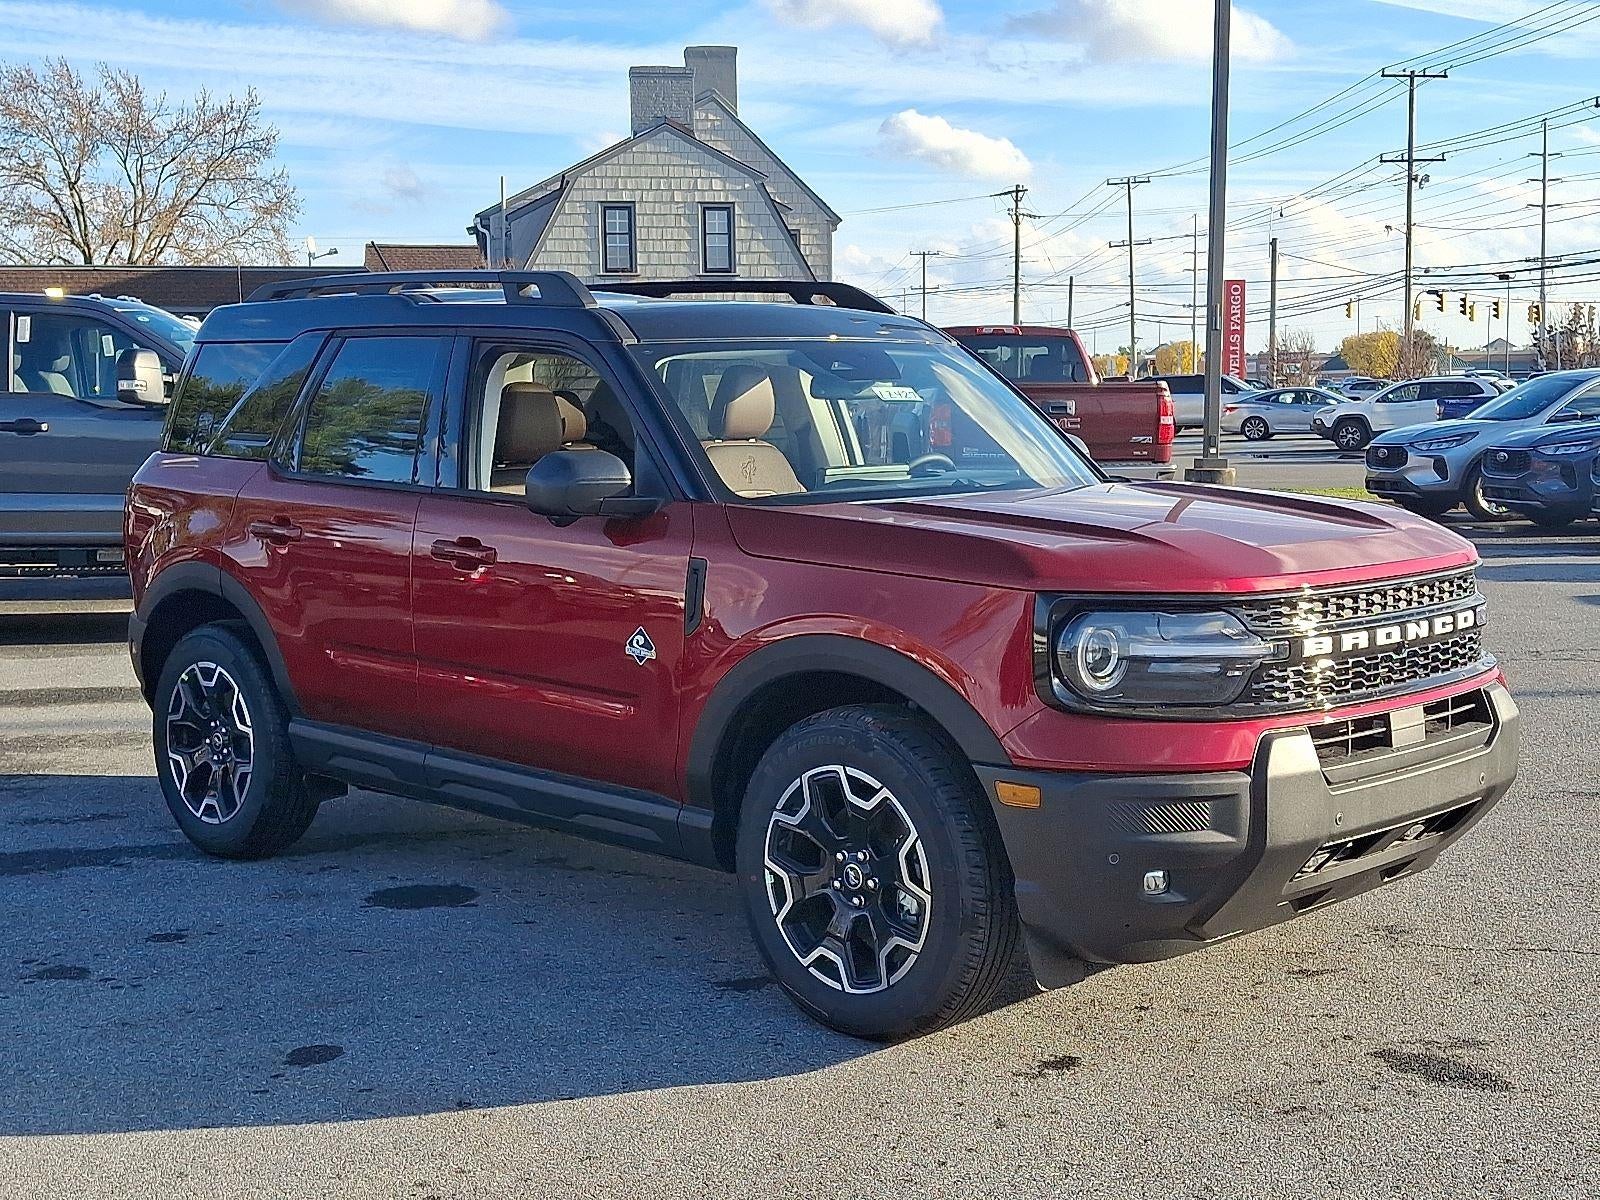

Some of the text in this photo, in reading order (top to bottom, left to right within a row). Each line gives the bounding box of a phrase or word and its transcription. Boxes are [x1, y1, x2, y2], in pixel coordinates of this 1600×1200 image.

[1230, 284, 1241, 331] FARGO
[1050, 417, 1081, 429] MC
[1302, 609, 1474, 658] BRONCO
